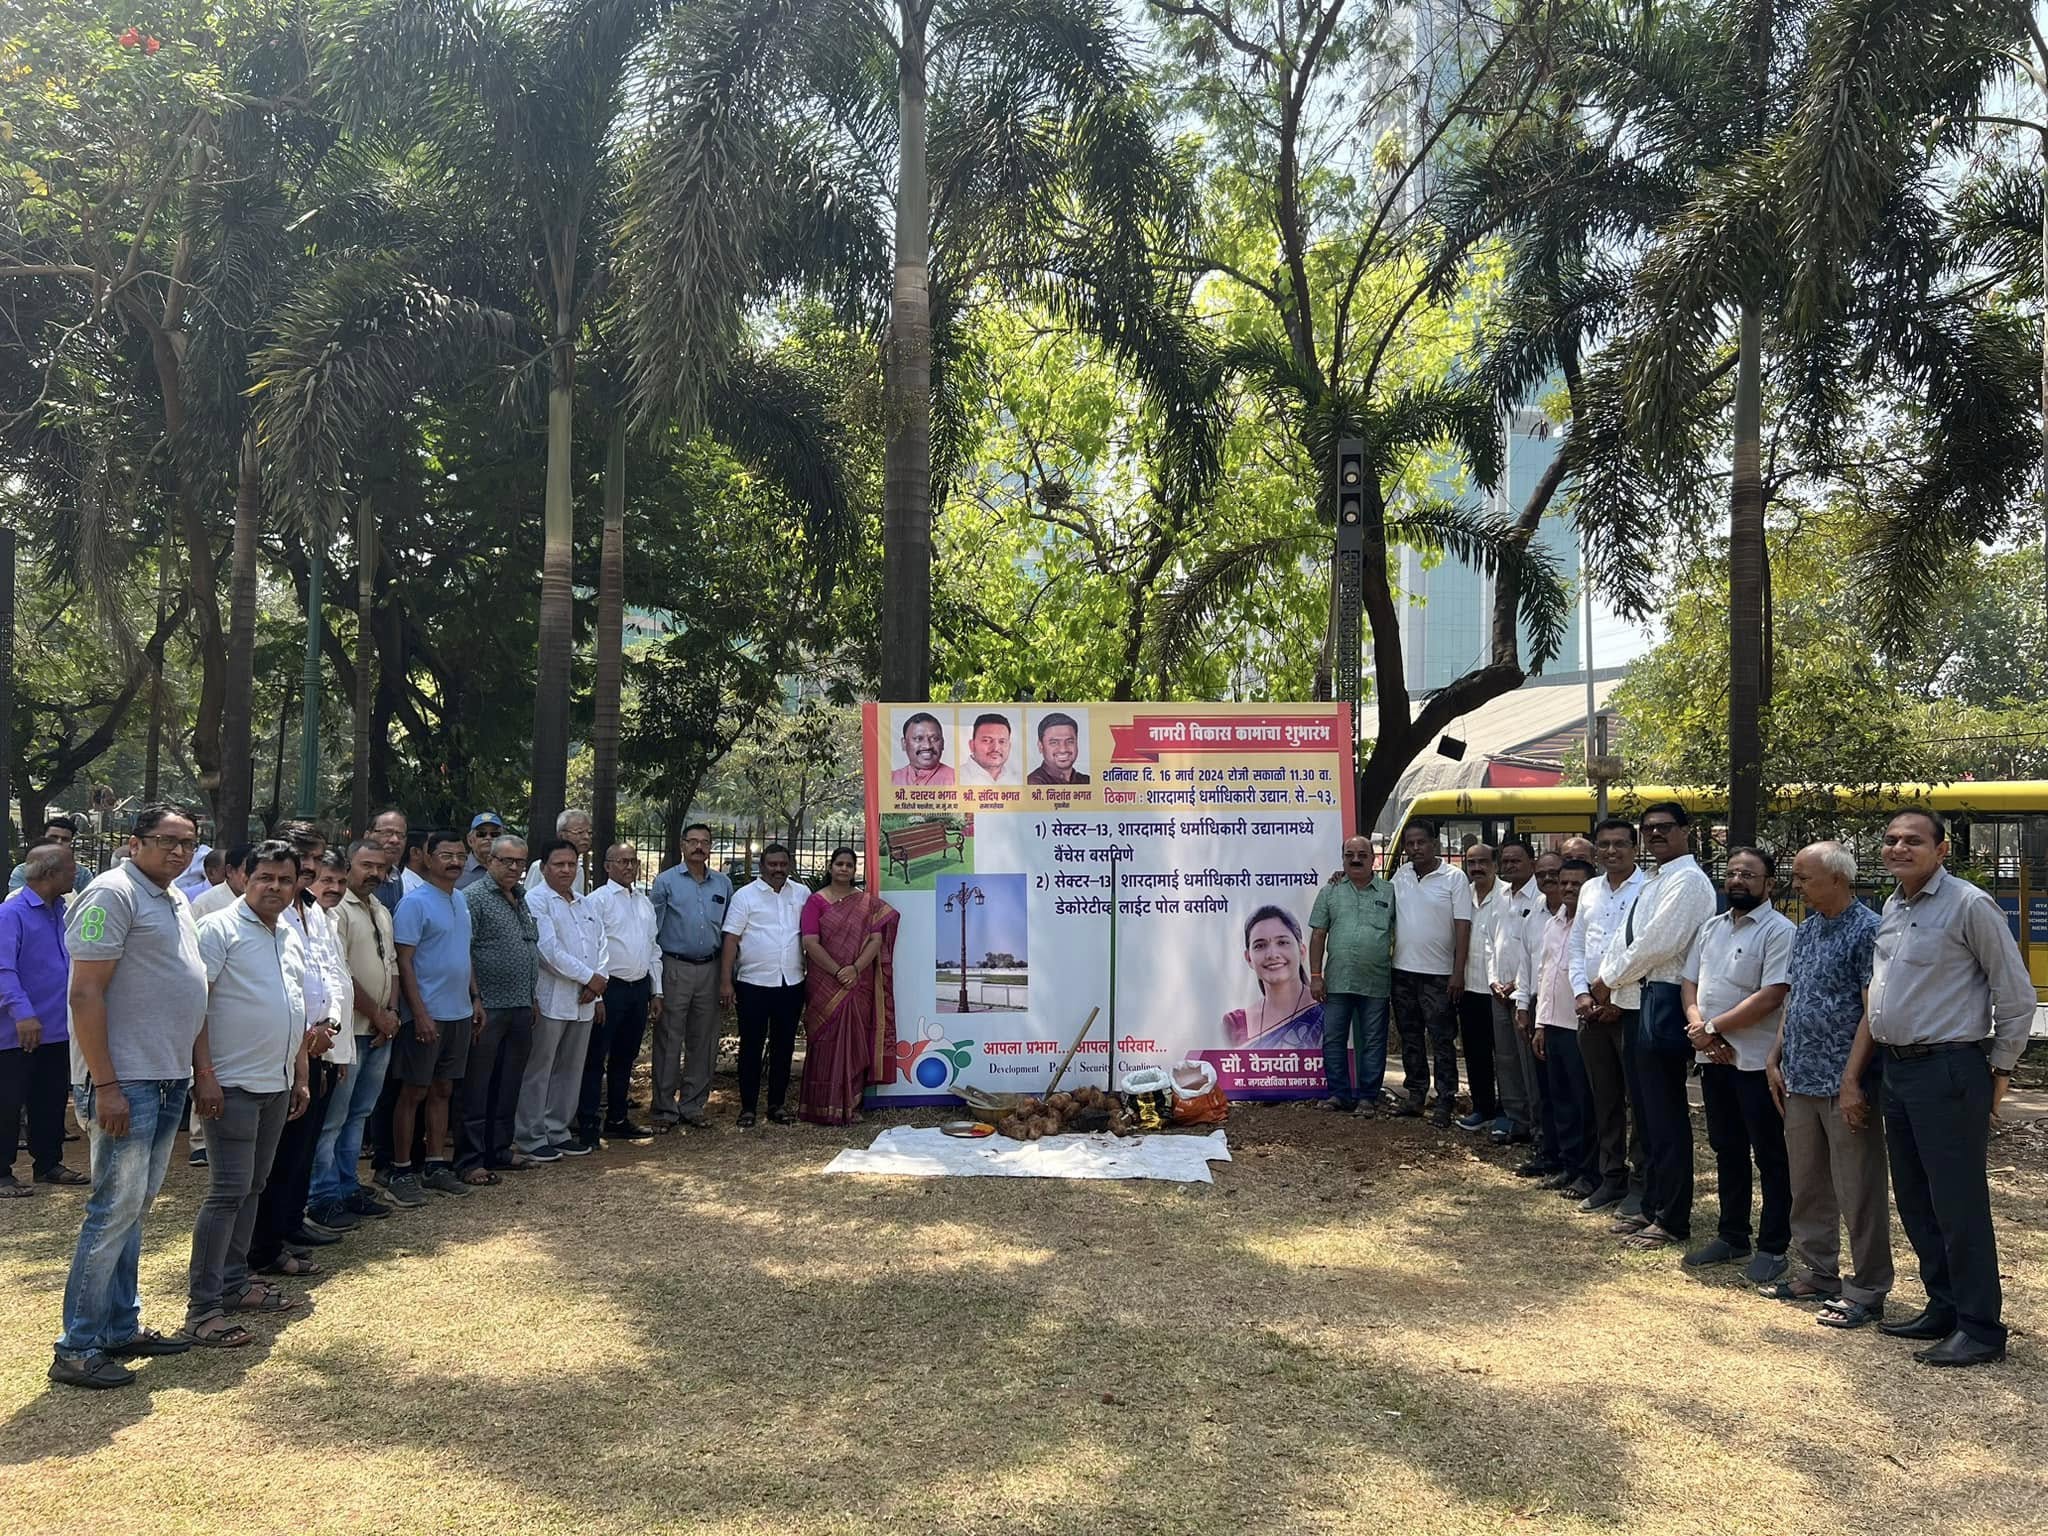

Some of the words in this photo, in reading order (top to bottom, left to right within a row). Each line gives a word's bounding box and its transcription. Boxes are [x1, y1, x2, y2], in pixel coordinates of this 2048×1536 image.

[1149, 723, 1186, 742] नागरी
[1190, 723, 1232, 742] विकास
[1235, 720, 1281, 742] कामांचा
[1285, 720, 1331, 747] शुभारंभ
[1102, 766, 1138, 782] शनिवार
[1143, 766, 1155, 782] दि.
[1160, 769, 1171, 782] 16
[1175, 766, 1195, 782] मार्च
[1199, 769, 1224, 782] 2024
[1228, 766, 1249, 782] रोजी
[1253, 766, 1286, 781] सकाळी
[1290, 768, 1315, 781] 11.30
[1319, 769, 1332, 781] वा.
[895, 788, 908, 801] श्री.
[910, 790, 936, 801] दशरथ
[938, 790, 958, 801] भगत
[963, 788, 976, 801] श्री.
[1001, 791, 1021, 801] भगत
[1031, 788, 1044, 801] श्री.
[1046, 788, 1071, 801] निशांत
[1073, 791, 1092, 801] भगत
[1104, 786, 1136, 804] ठिकाण
[1146, 785, 1196, 806] शारदामाई
[1199, 785, 1256, 804] धर्माधिकारी
[1035, 820, 1046, 840] 1)
[1118, 817, 1176, 839] शारदामाई
[1180, 817, 1247, 835] धर्माधिकारी
[1251, 817, 1314, 836] उद्यानामध्ये
[1054, 843, 1085, 862] बैंचेस
[1089, 843, 1134, 862] बसविणे
[1036, 872, 1049, 891] 2)
[1121, 869, 1179, 890] शारदामाई
[1184, 868, 1251, 887] धर्माधिकारी
[1255, 868, 1319, 887] उद्यानामध्ये
[1118, 895, 1151, 917] लाईट
[1155, 895, 1180, 914] पोल
[1184, 894, 1229, 914] बसविणे
[81, 905, 106, 942] 8
[984, 1041, 1022, 1055] आपला
[1117, 1035, 1167, 1053] परिवार...
[989, 1063, 1039, 1075] Development
[1220, 1053, 1246, 1073] सौ.
[1249, 1052, 1300, 1073] वैजयंती
[1234, 1077, 1246, 1087] मा.
[1248, 1075, 1287, 1087] नगरसेविका
[1288, 1077, 1308, 1087] प्रभाग
